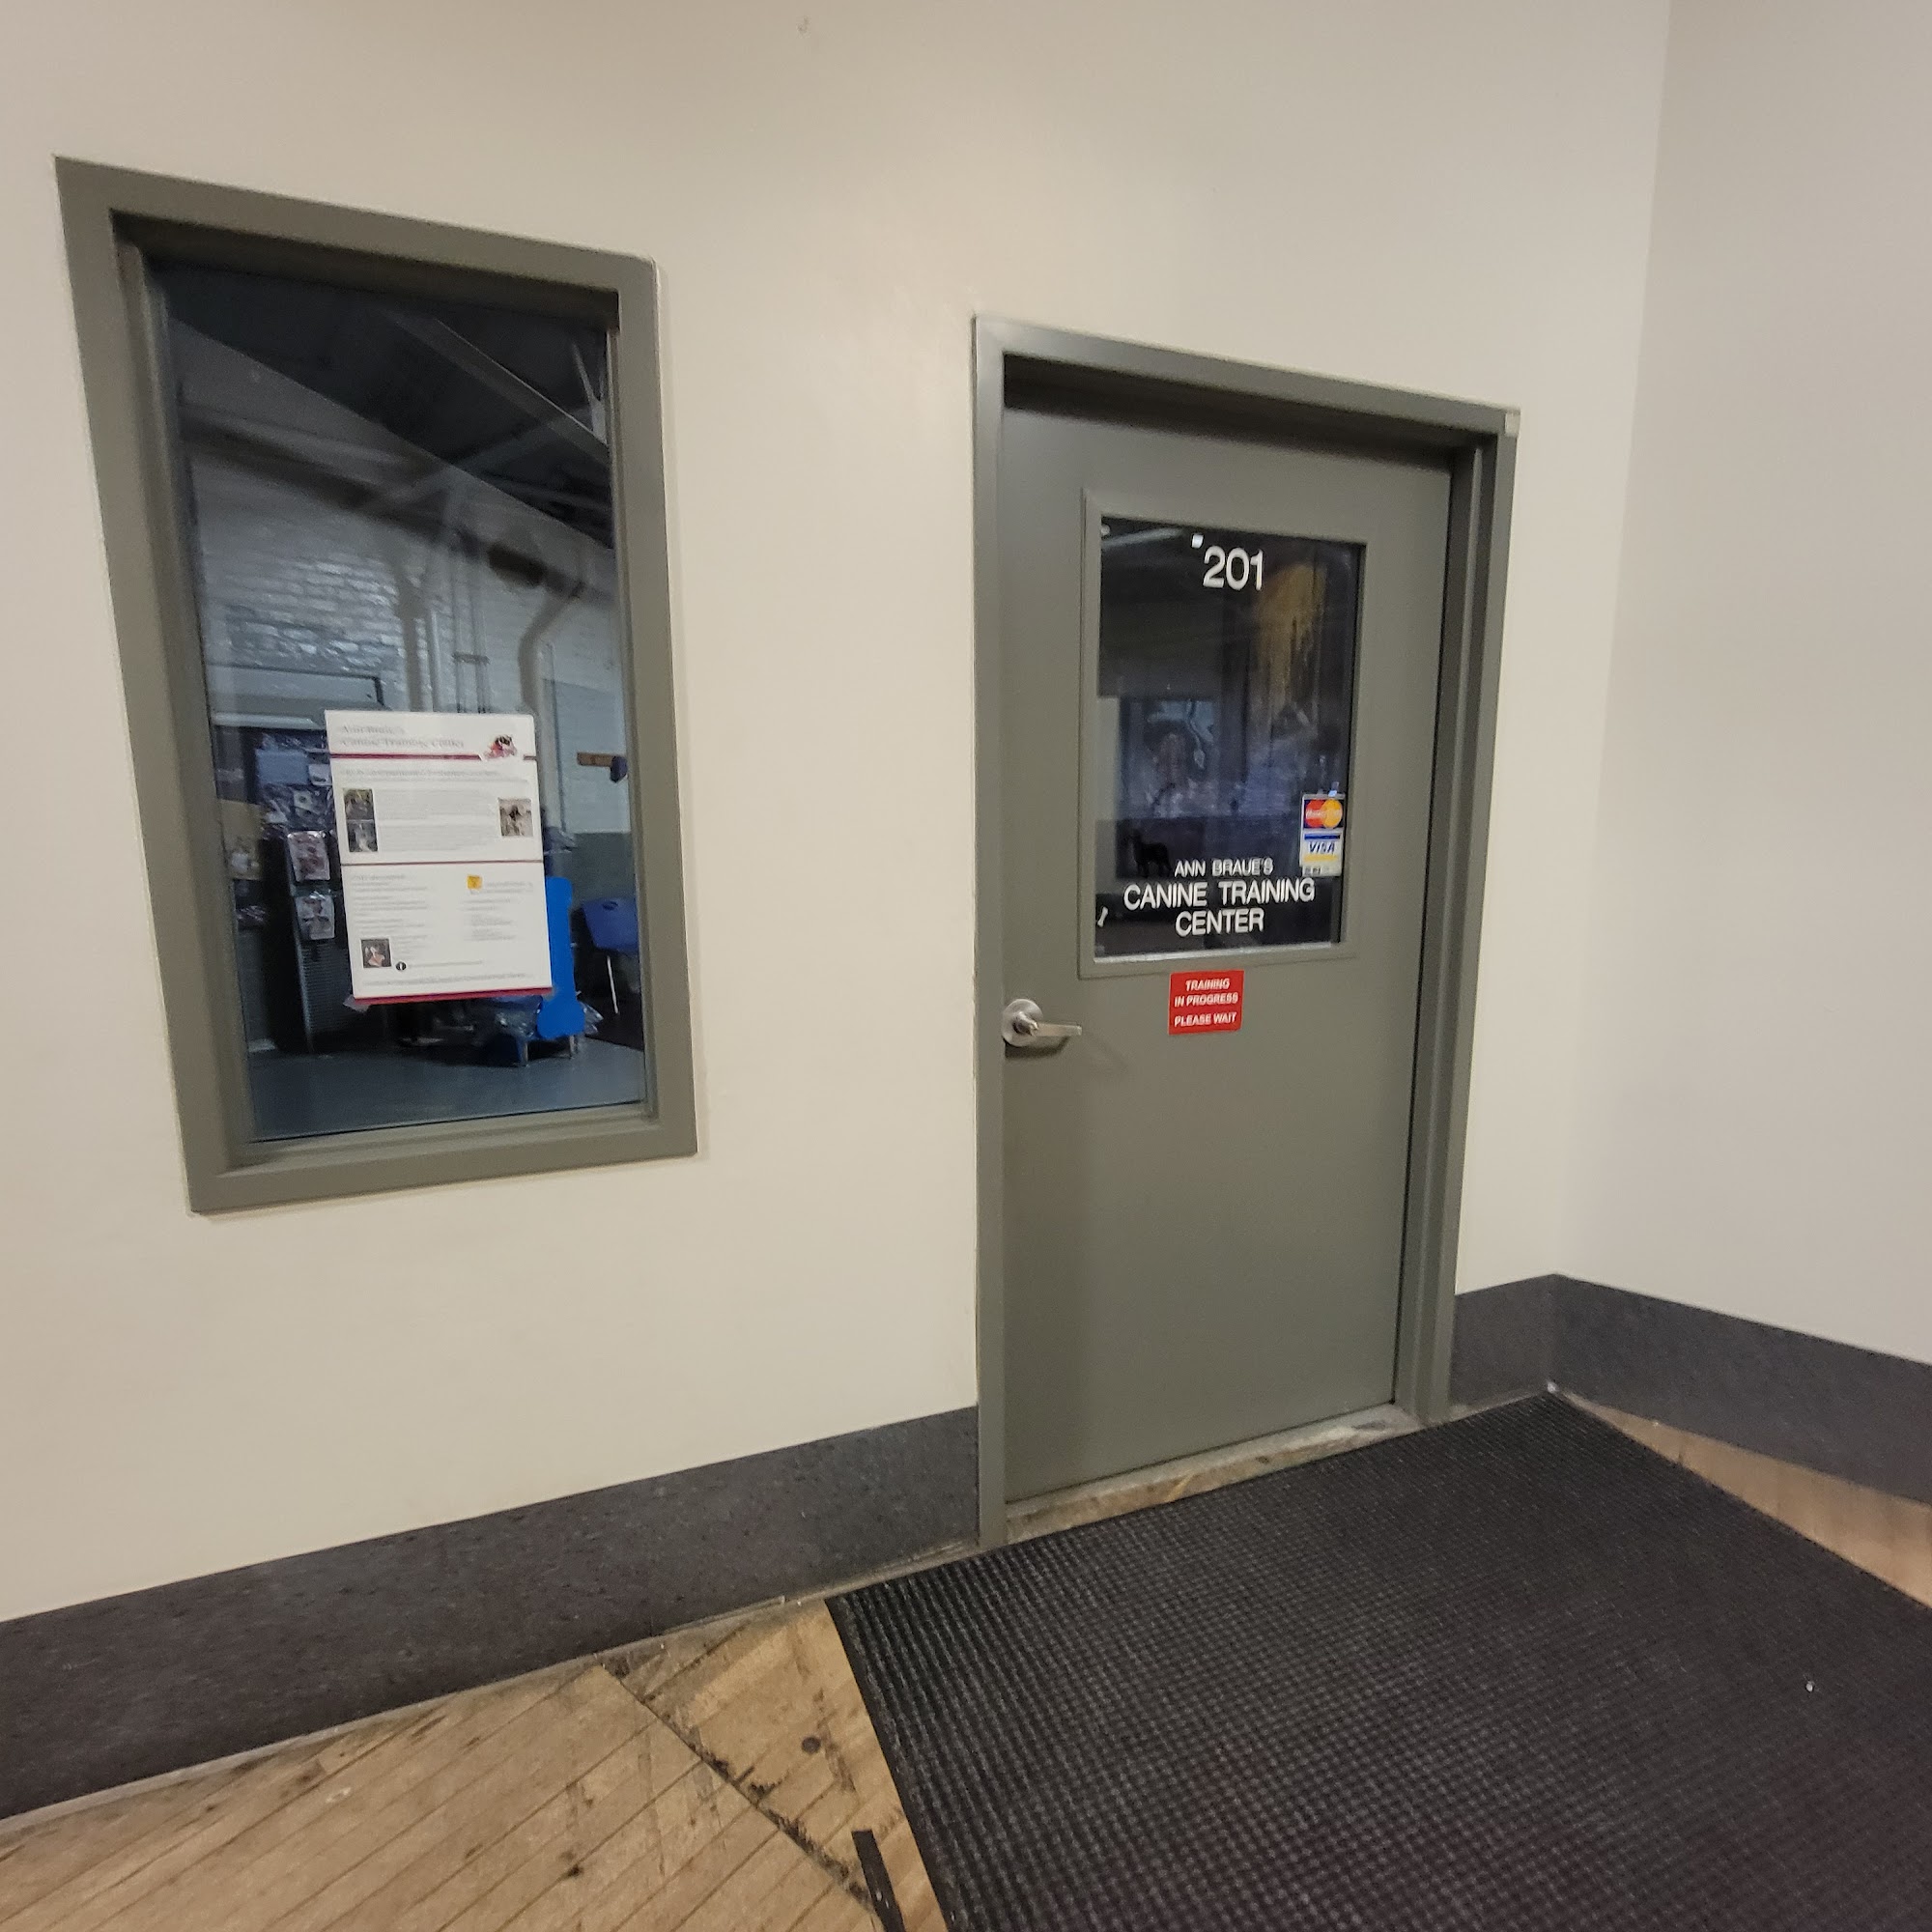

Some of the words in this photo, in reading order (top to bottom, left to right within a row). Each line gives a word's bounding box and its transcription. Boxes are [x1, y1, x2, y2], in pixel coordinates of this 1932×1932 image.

[1203, 545, 1264, 591] 201
[1309, 841, 1335, 854] VISA
[1175, 859, 1207, 877] ANN
[1123, 881, 1208, 911] CANINE
[1218, 877, 1316, 906] TRAINING
[1176, 907, 1265, 937] CENTER
[1185, 978, 1231, 992] TRAINING
[1174, 995, 1185, 1008] IN
[1186, 991, 1238, 1007] PROGRESS
[1174, 1012, 1212, 1027] PLEASE
[1213, 1011, 1237, 1024] WAIT
